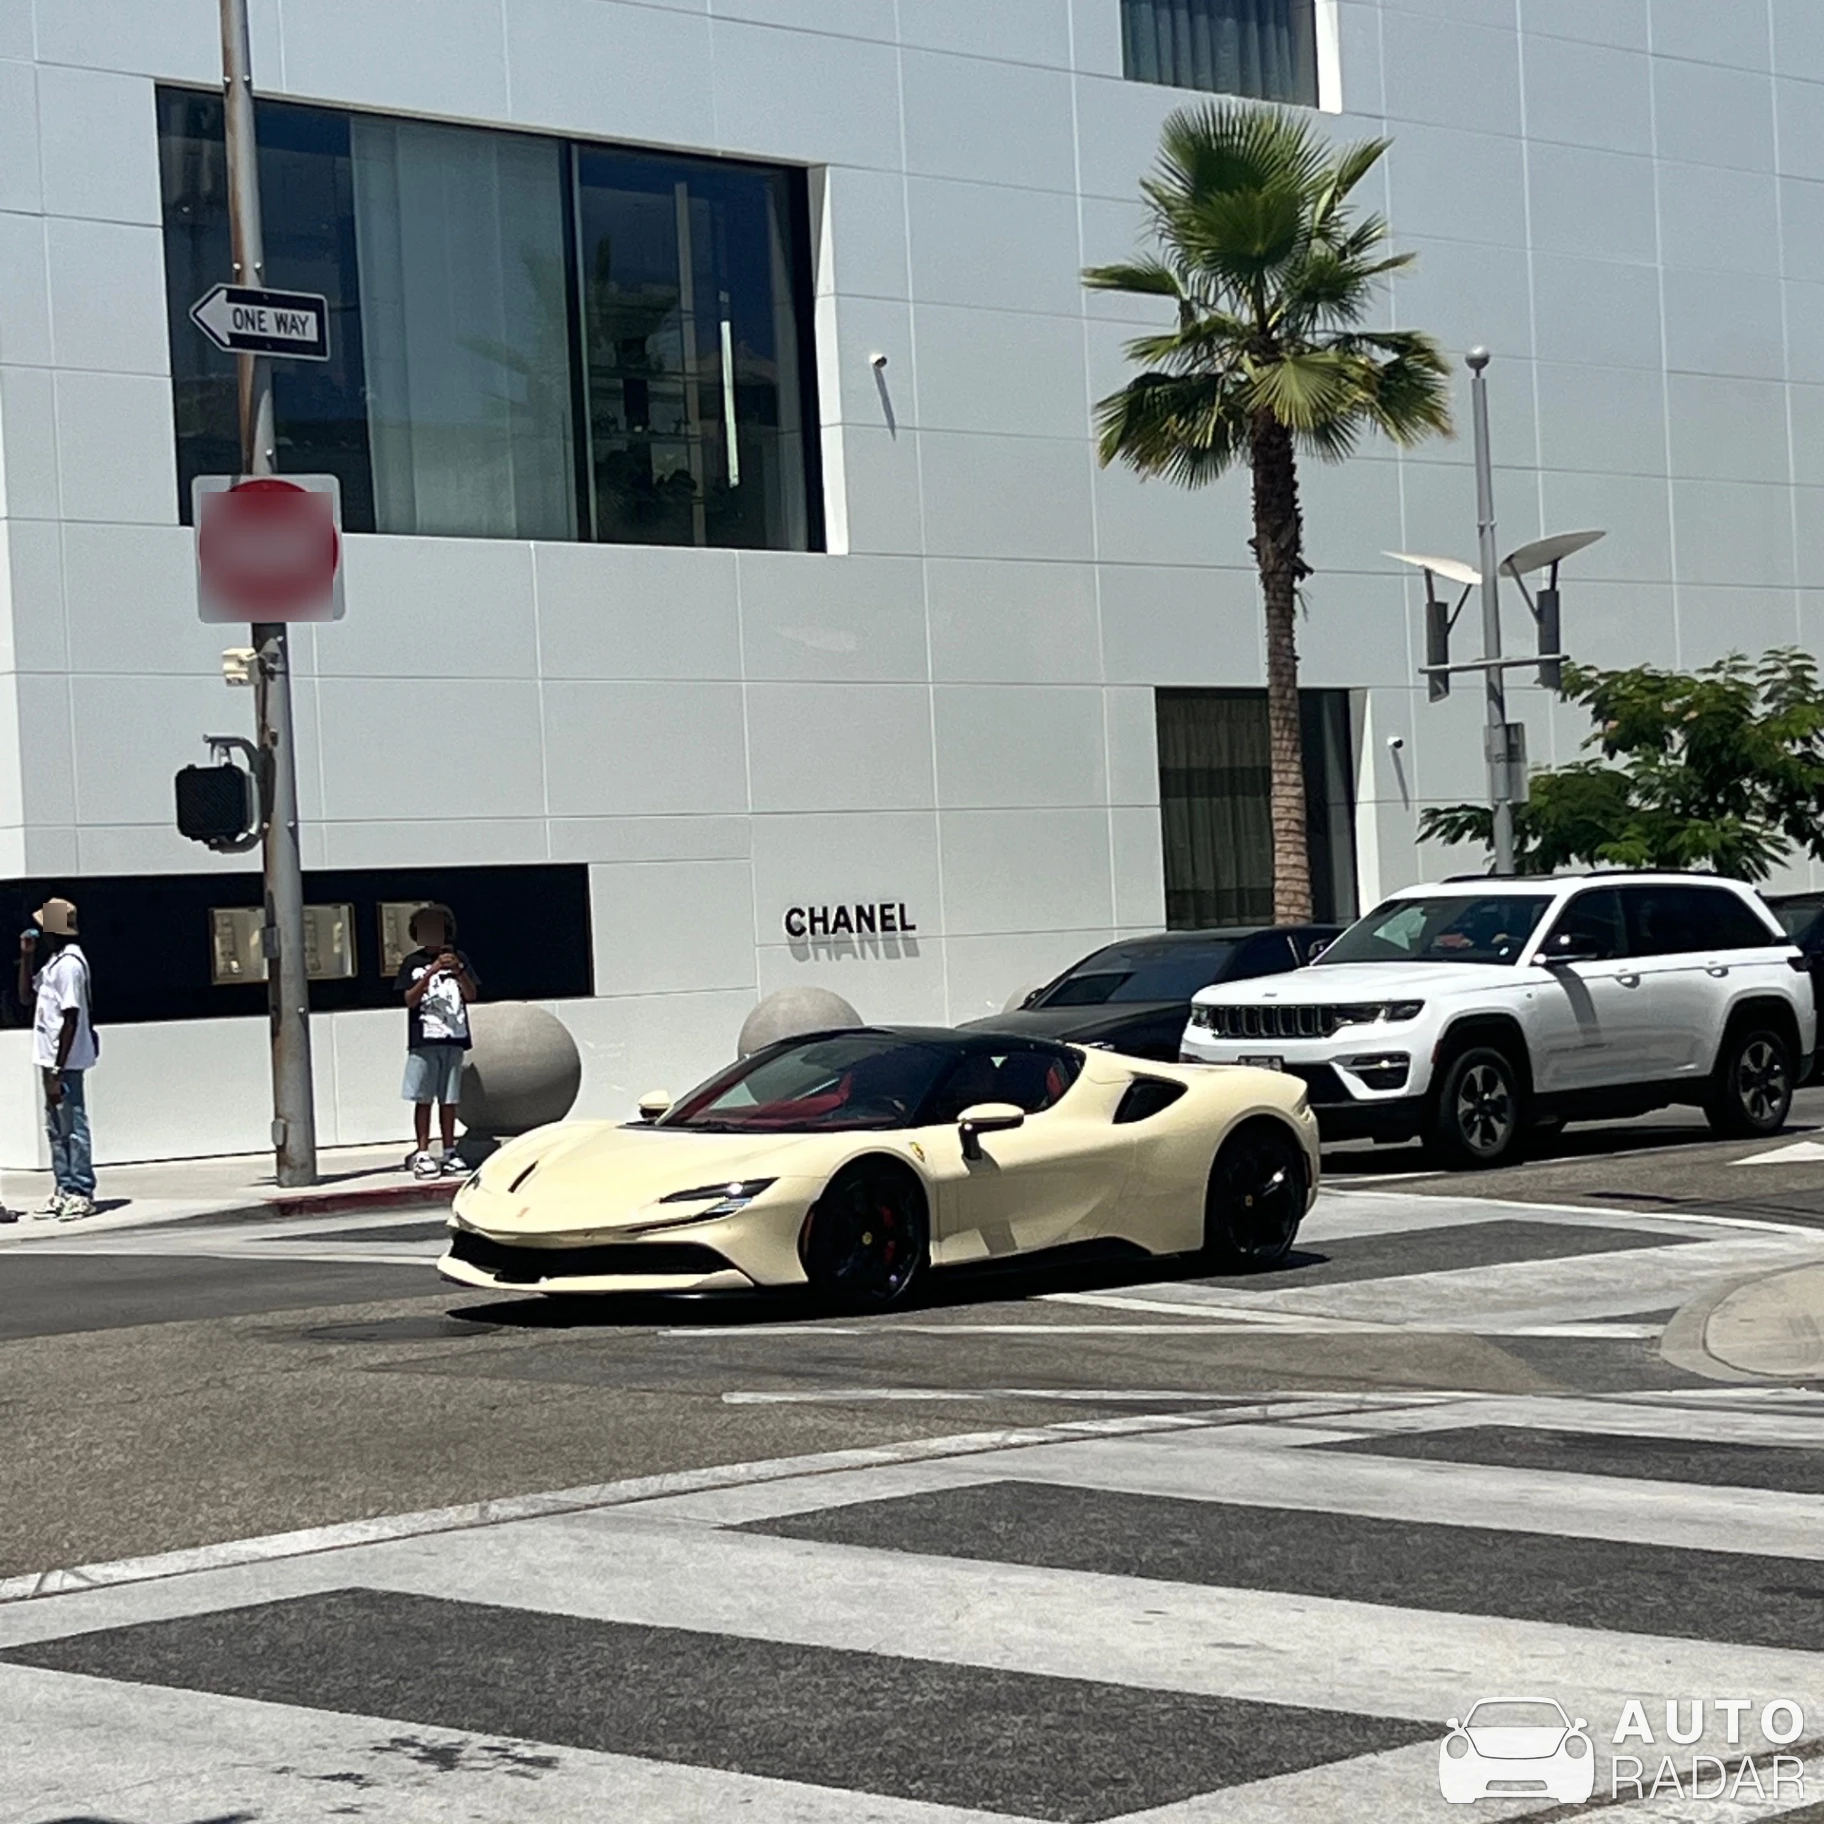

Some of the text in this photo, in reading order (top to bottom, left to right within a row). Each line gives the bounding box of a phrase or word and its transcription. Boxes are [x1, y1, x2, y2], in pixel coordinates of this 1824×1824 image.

[232, 307, 310, 336] ONE WAY
[785, 903, 917, 937] CHANEL
